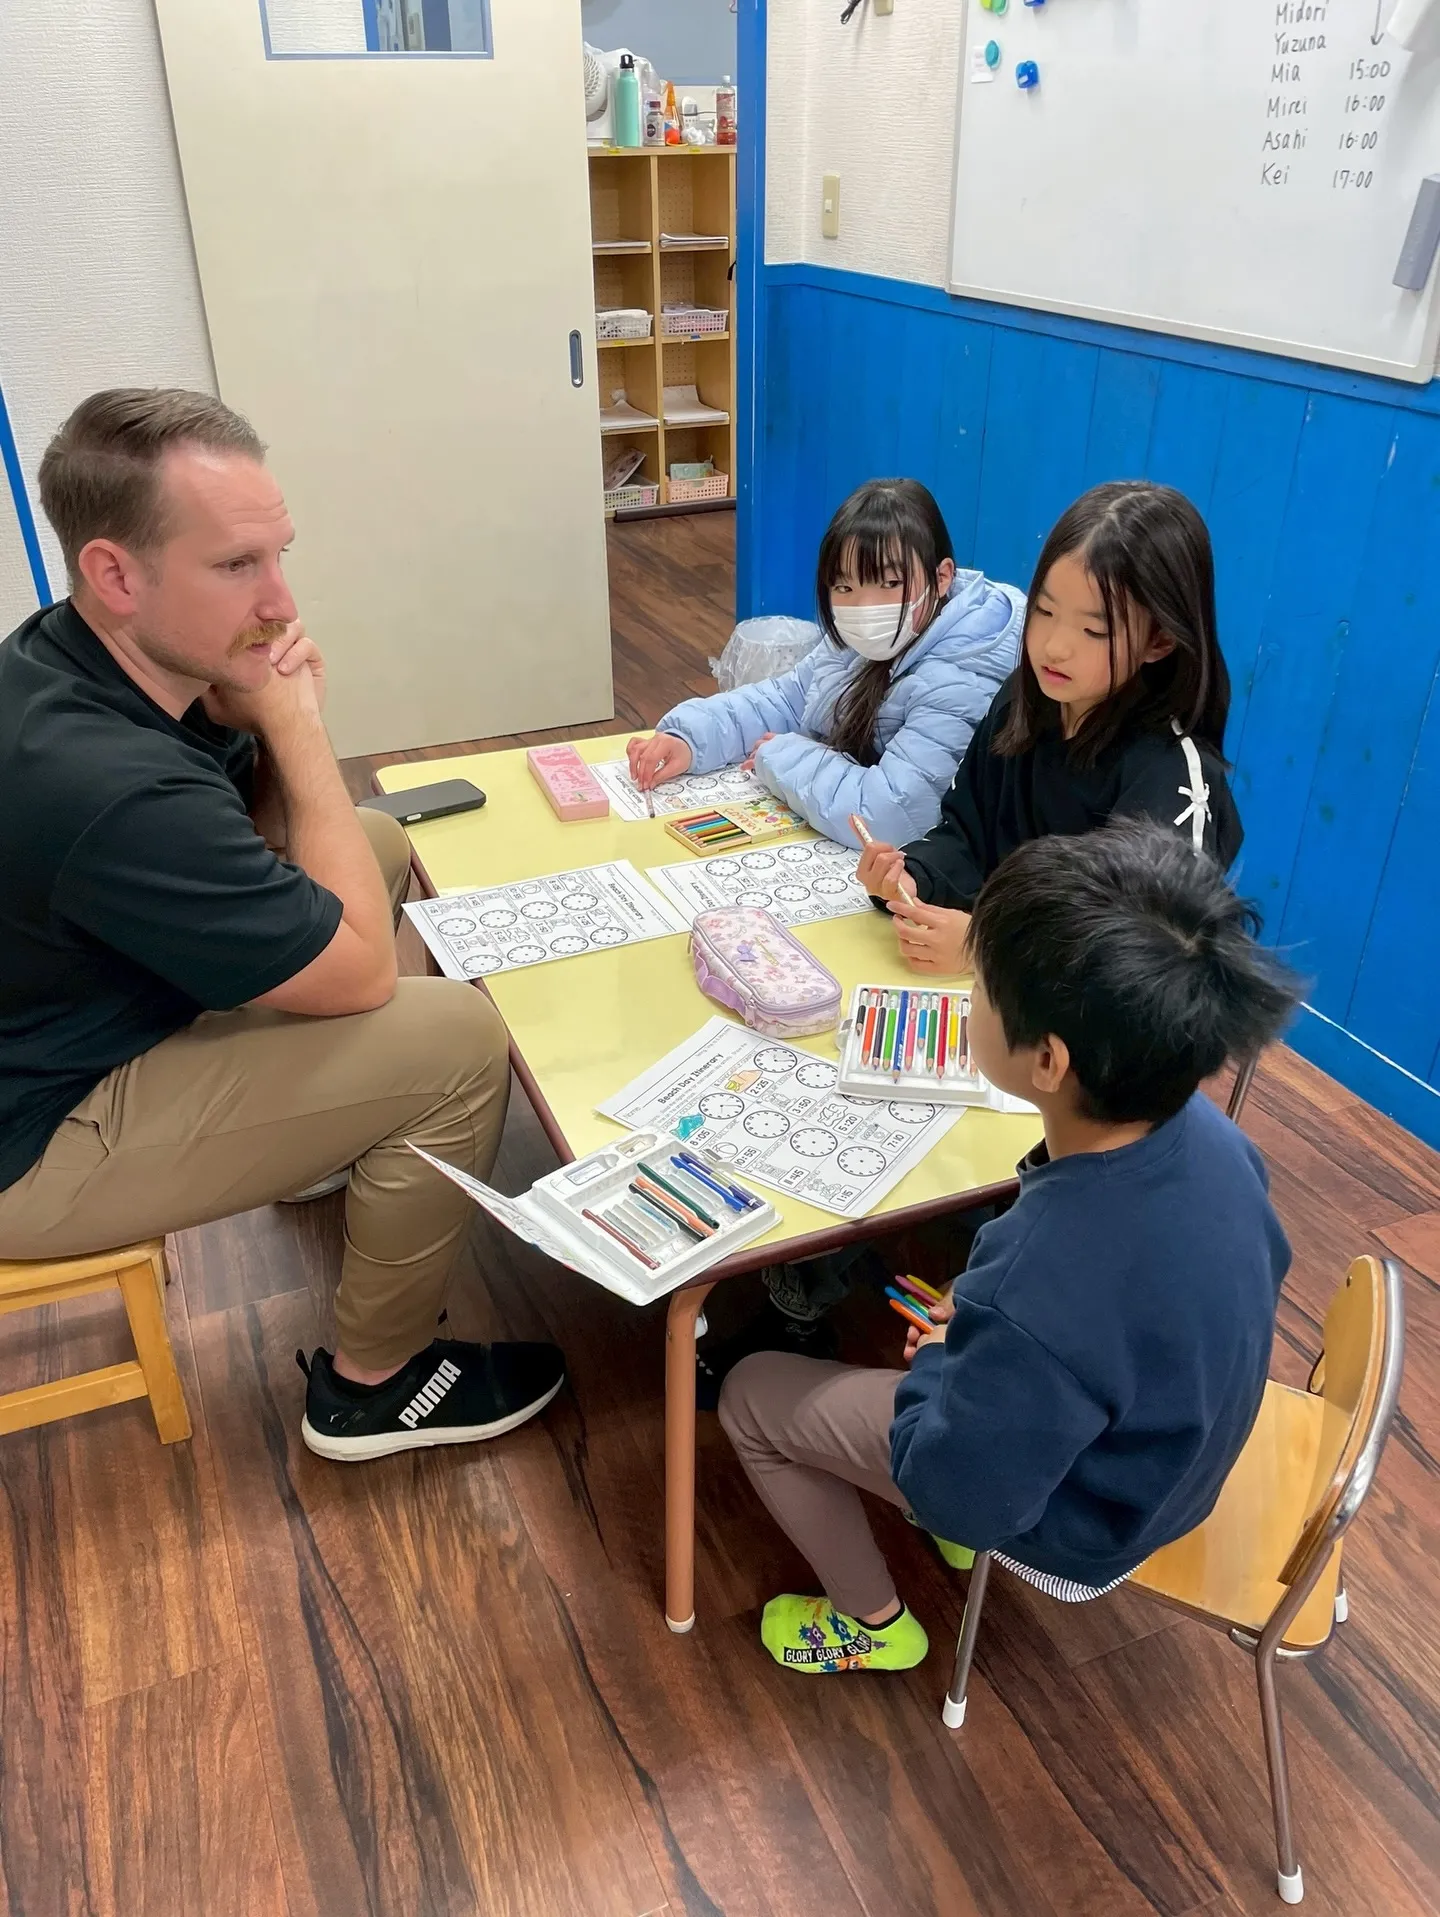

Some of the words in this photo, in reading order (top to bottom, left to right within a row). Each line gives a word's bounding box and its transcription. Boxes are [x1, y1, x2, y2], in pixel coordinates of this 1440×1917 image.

[1276, 0, 1329, 26] Midori
[1275, 32, 1327, 55] Yuzuna
[1271, 62, 1301, 83] Mia
[1349, 59, 1391, 80] 15:00
[1266, 95, 1308, 118] Mirei
[1344, 94, 1386, 114] 16:00
[1262, 128, 1308, 151] Asahi
[1338, 131, 1378, 150] 16:00
[1260, 162, 1290, 186] Kei
[1332, 169, 1373, 189] 17:00
[658, 1082, 682, 1104] Beach
[678, 1073, 696, 1088] Day
[690, 1053, 724, 1081] Itinerary
[750, 1079, 770, 1095] 2:25
[792, 1098, 812, 1114] 3:50
[838, 1115, 857, 1132] 5:20
[690, 1129, 711, 1146] 8:05
[886, 1133, 905, 1148] 7:10
[735, 1148, 757, 1166] 10:55
[836, 1189, 853, 1203] 1:15
[398, 1359, 462, 1429] PUMA
[786, 1649, 812, 1663] GLORY
[816, 1647, 845, 1662] GLORY
[847, 1633, 871, 1655] GLORY
